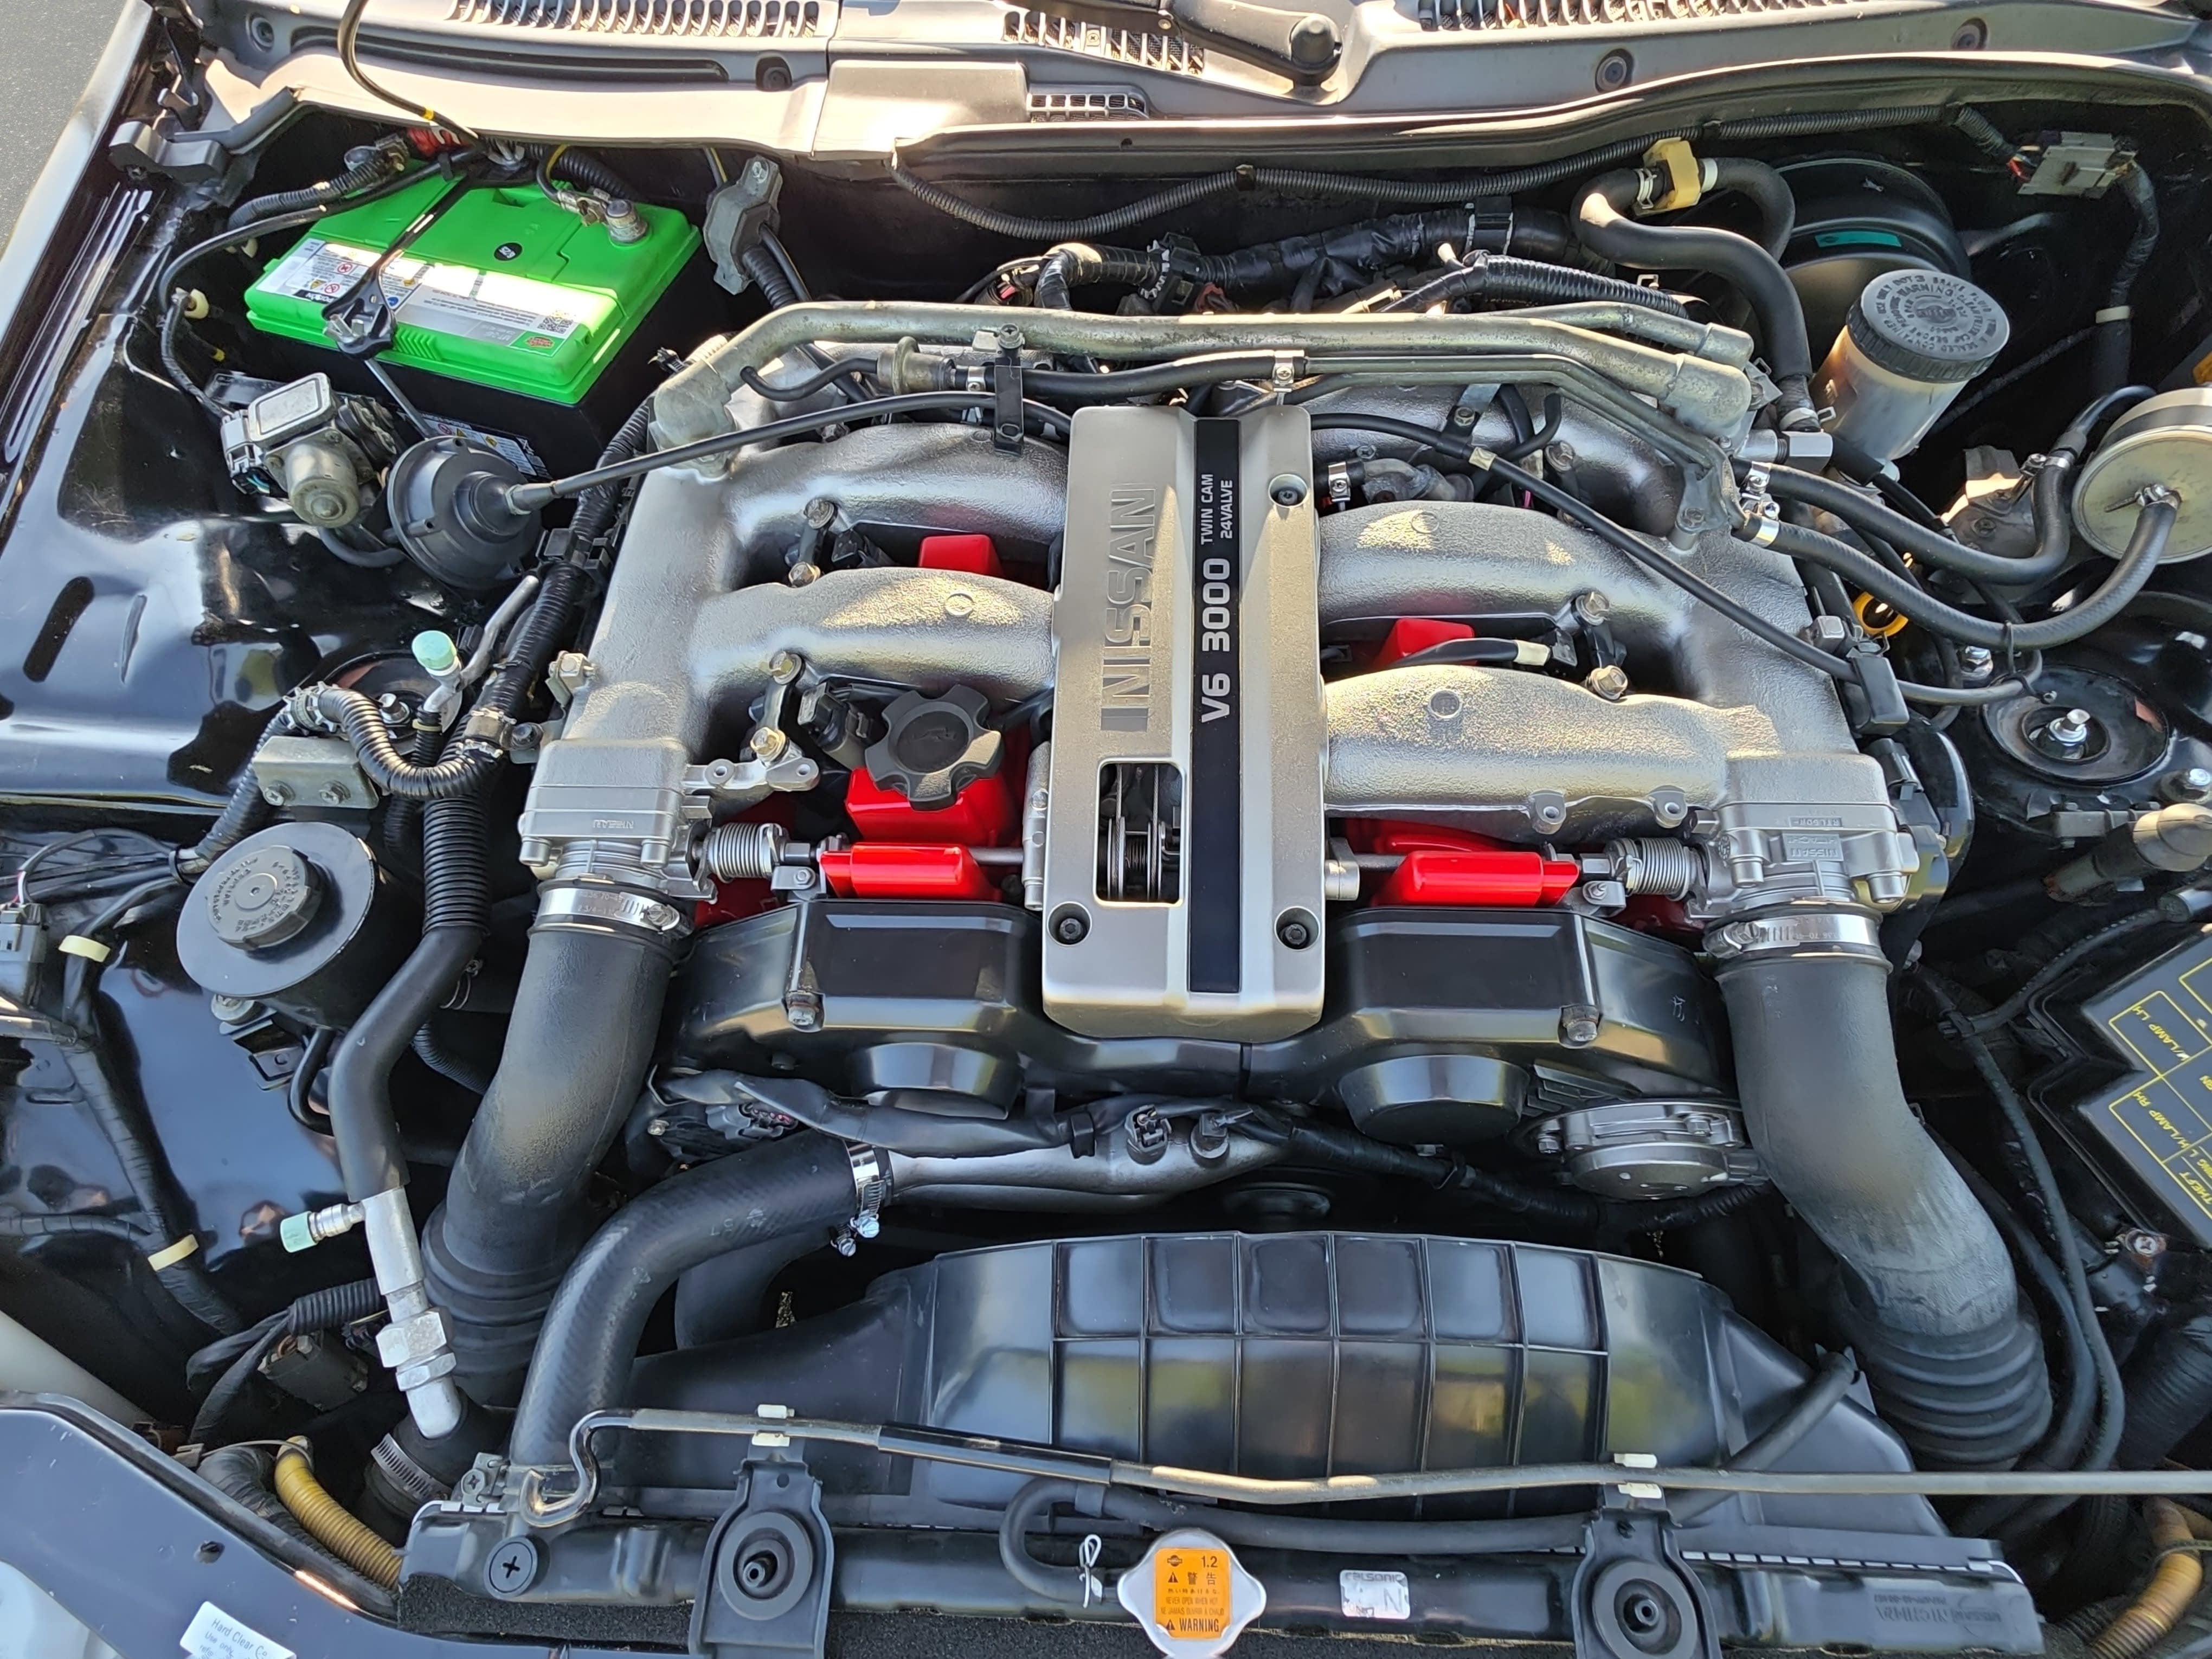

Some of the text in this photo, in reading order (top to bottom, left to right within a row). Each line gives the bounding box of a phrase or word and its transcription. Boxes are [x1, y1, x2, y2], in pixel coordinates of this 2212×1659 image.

[1893, 275, 1913, 286] DOT
[1896, 283, 1954, 297] WARNING
[1201, 473, 1214, 545] TWIN CAM
[1220, 479, 1233, 539] 24VALVE
[1101, 485, 1156, 732] NISSAN
[1201, 557, 1231, 724] V6 3000
[1790, 848, 1839, 857] NISSAN
[2131, 1005, 2151, 1021] LH
[2132, 1090, 2191, 1149] H/LAMP RH
[2179, 1171, 2212, 1205] THEFT
[1200, 1555, 1218, 1568] 1.2
[1187, 1572, 1217, 1585] 警告
[211, 1617, 233, 1637] Hard
[232, 1631, 254, 1650] Clear
[1179, 1617, 1219, 1632] WARNING
